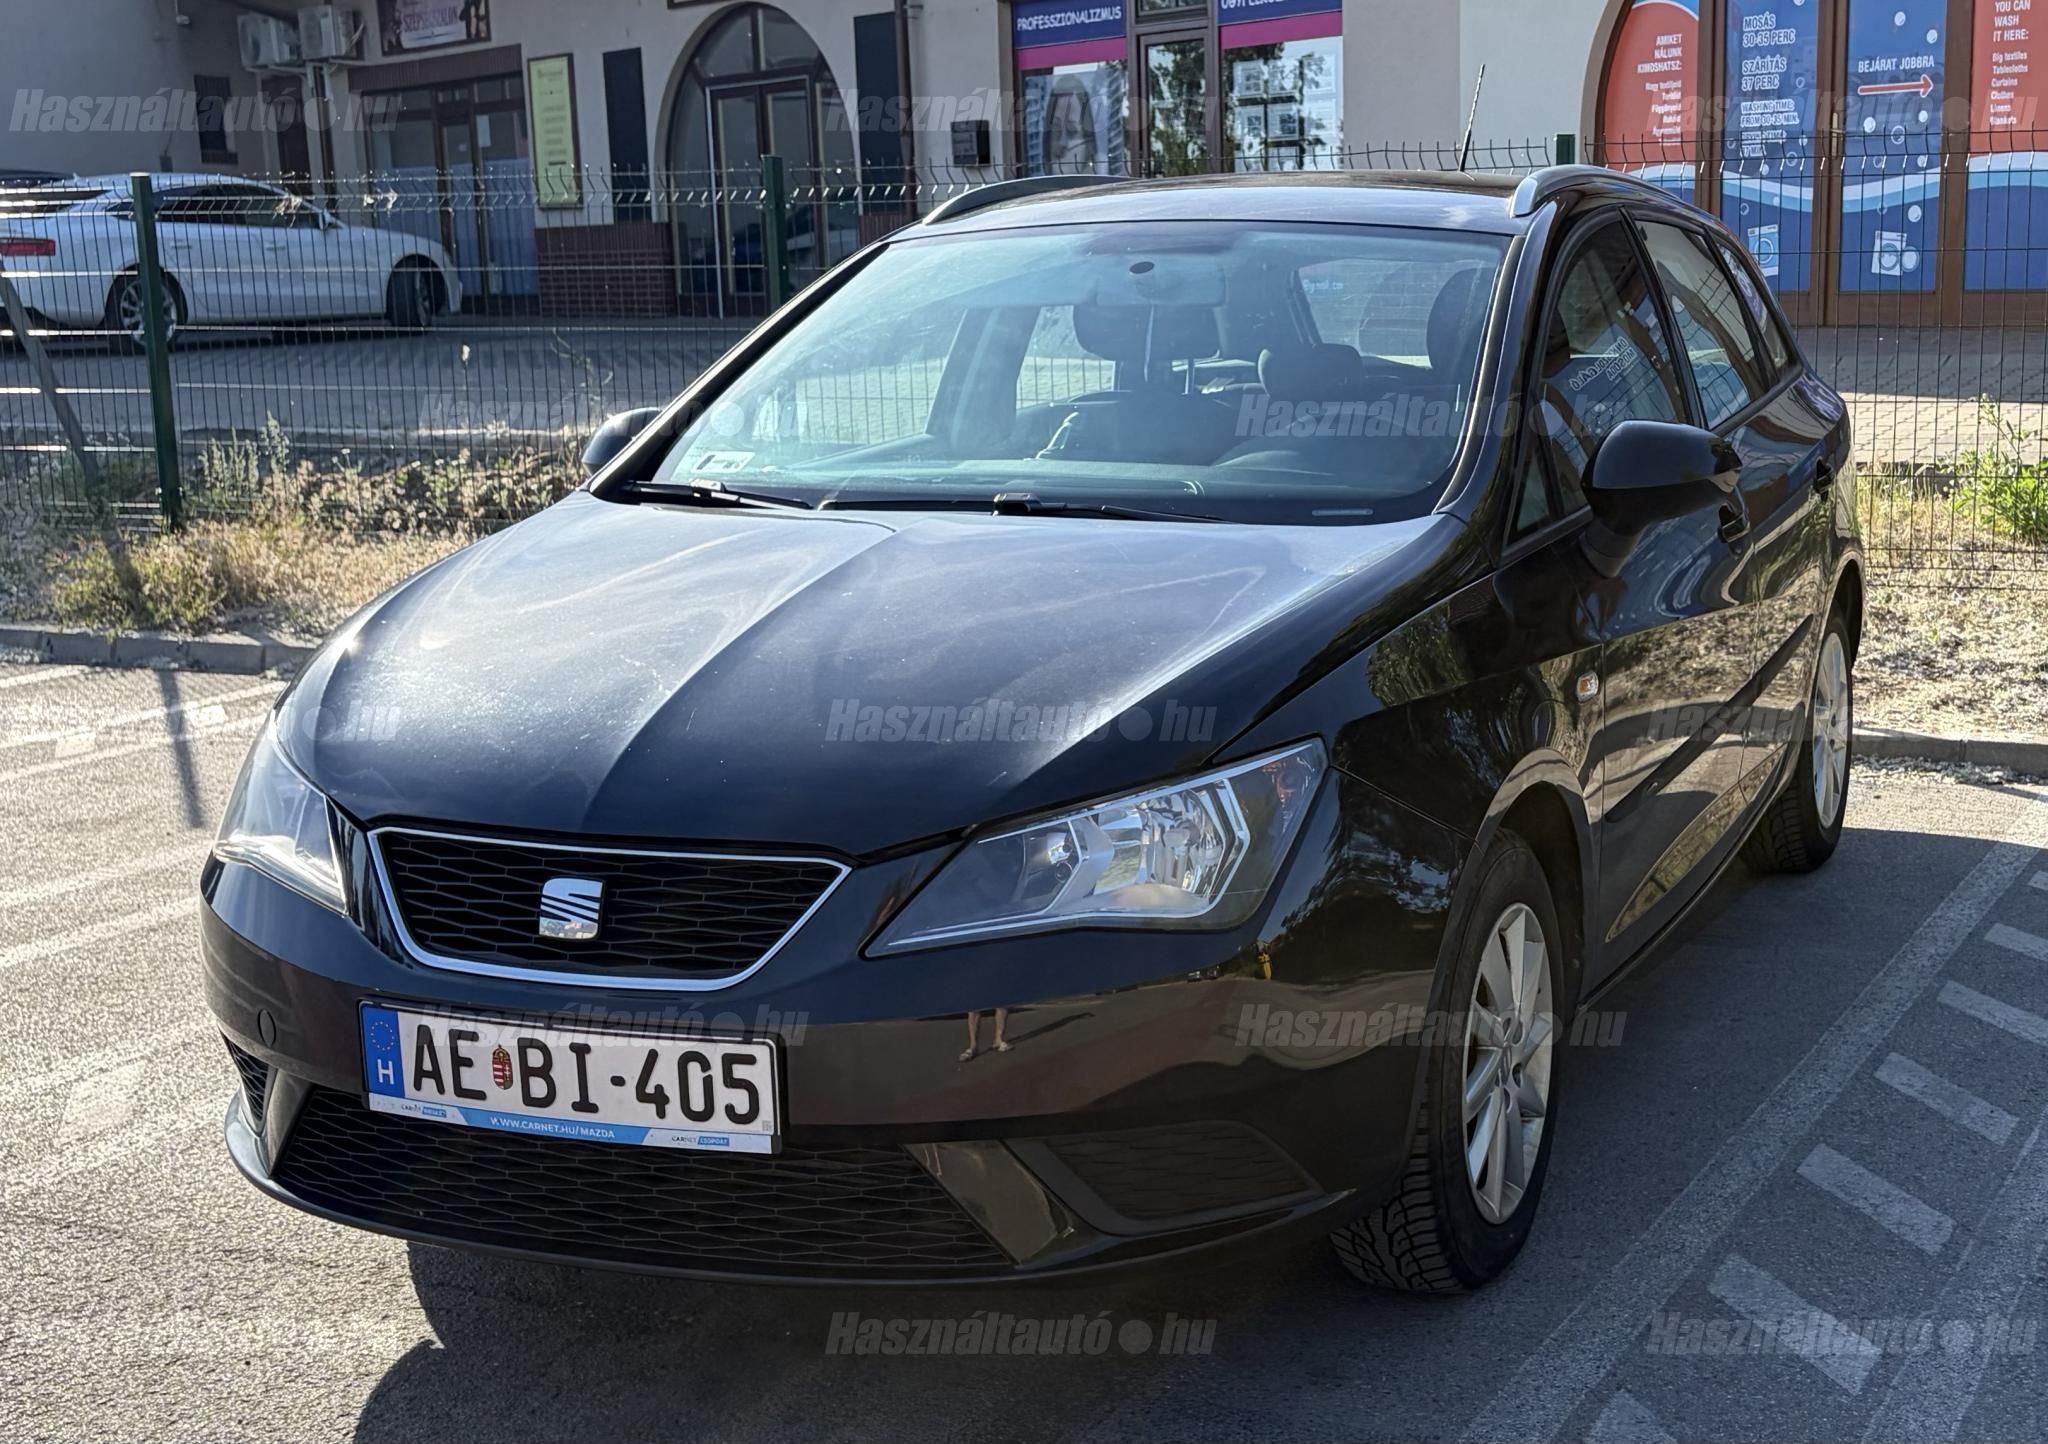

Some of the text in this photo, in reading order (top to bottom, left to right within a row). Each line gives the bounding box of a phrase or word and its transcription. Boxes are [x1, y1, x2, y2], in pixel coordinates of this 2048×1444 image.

[1994, 0, 2031, 12] YOU CAN
[1016, 6, 1122, 31] PROFESSZIONALIZMUS
[1743, 12, 1776, 31] MOSÁS
[1994, 15, 2019, 27] WASH
[1743, 28, 1796, 47] 30-35 PERC
[1993, 29, 2029, 42] IT HERE:
[1742, 54, 1787, 75] SZÁRÍTÁS
[1858, 55, 1935, 73] BEJÁRAT JOBBRA
[1741, 74, 1779, 92] 37 PERC
[1741, 101, 1773, 114] WASHING
[1740, 114, 1761, 127] FROM
[413, 1024, 488, 1101] AE
[377, 1059, 395, 1085] H
